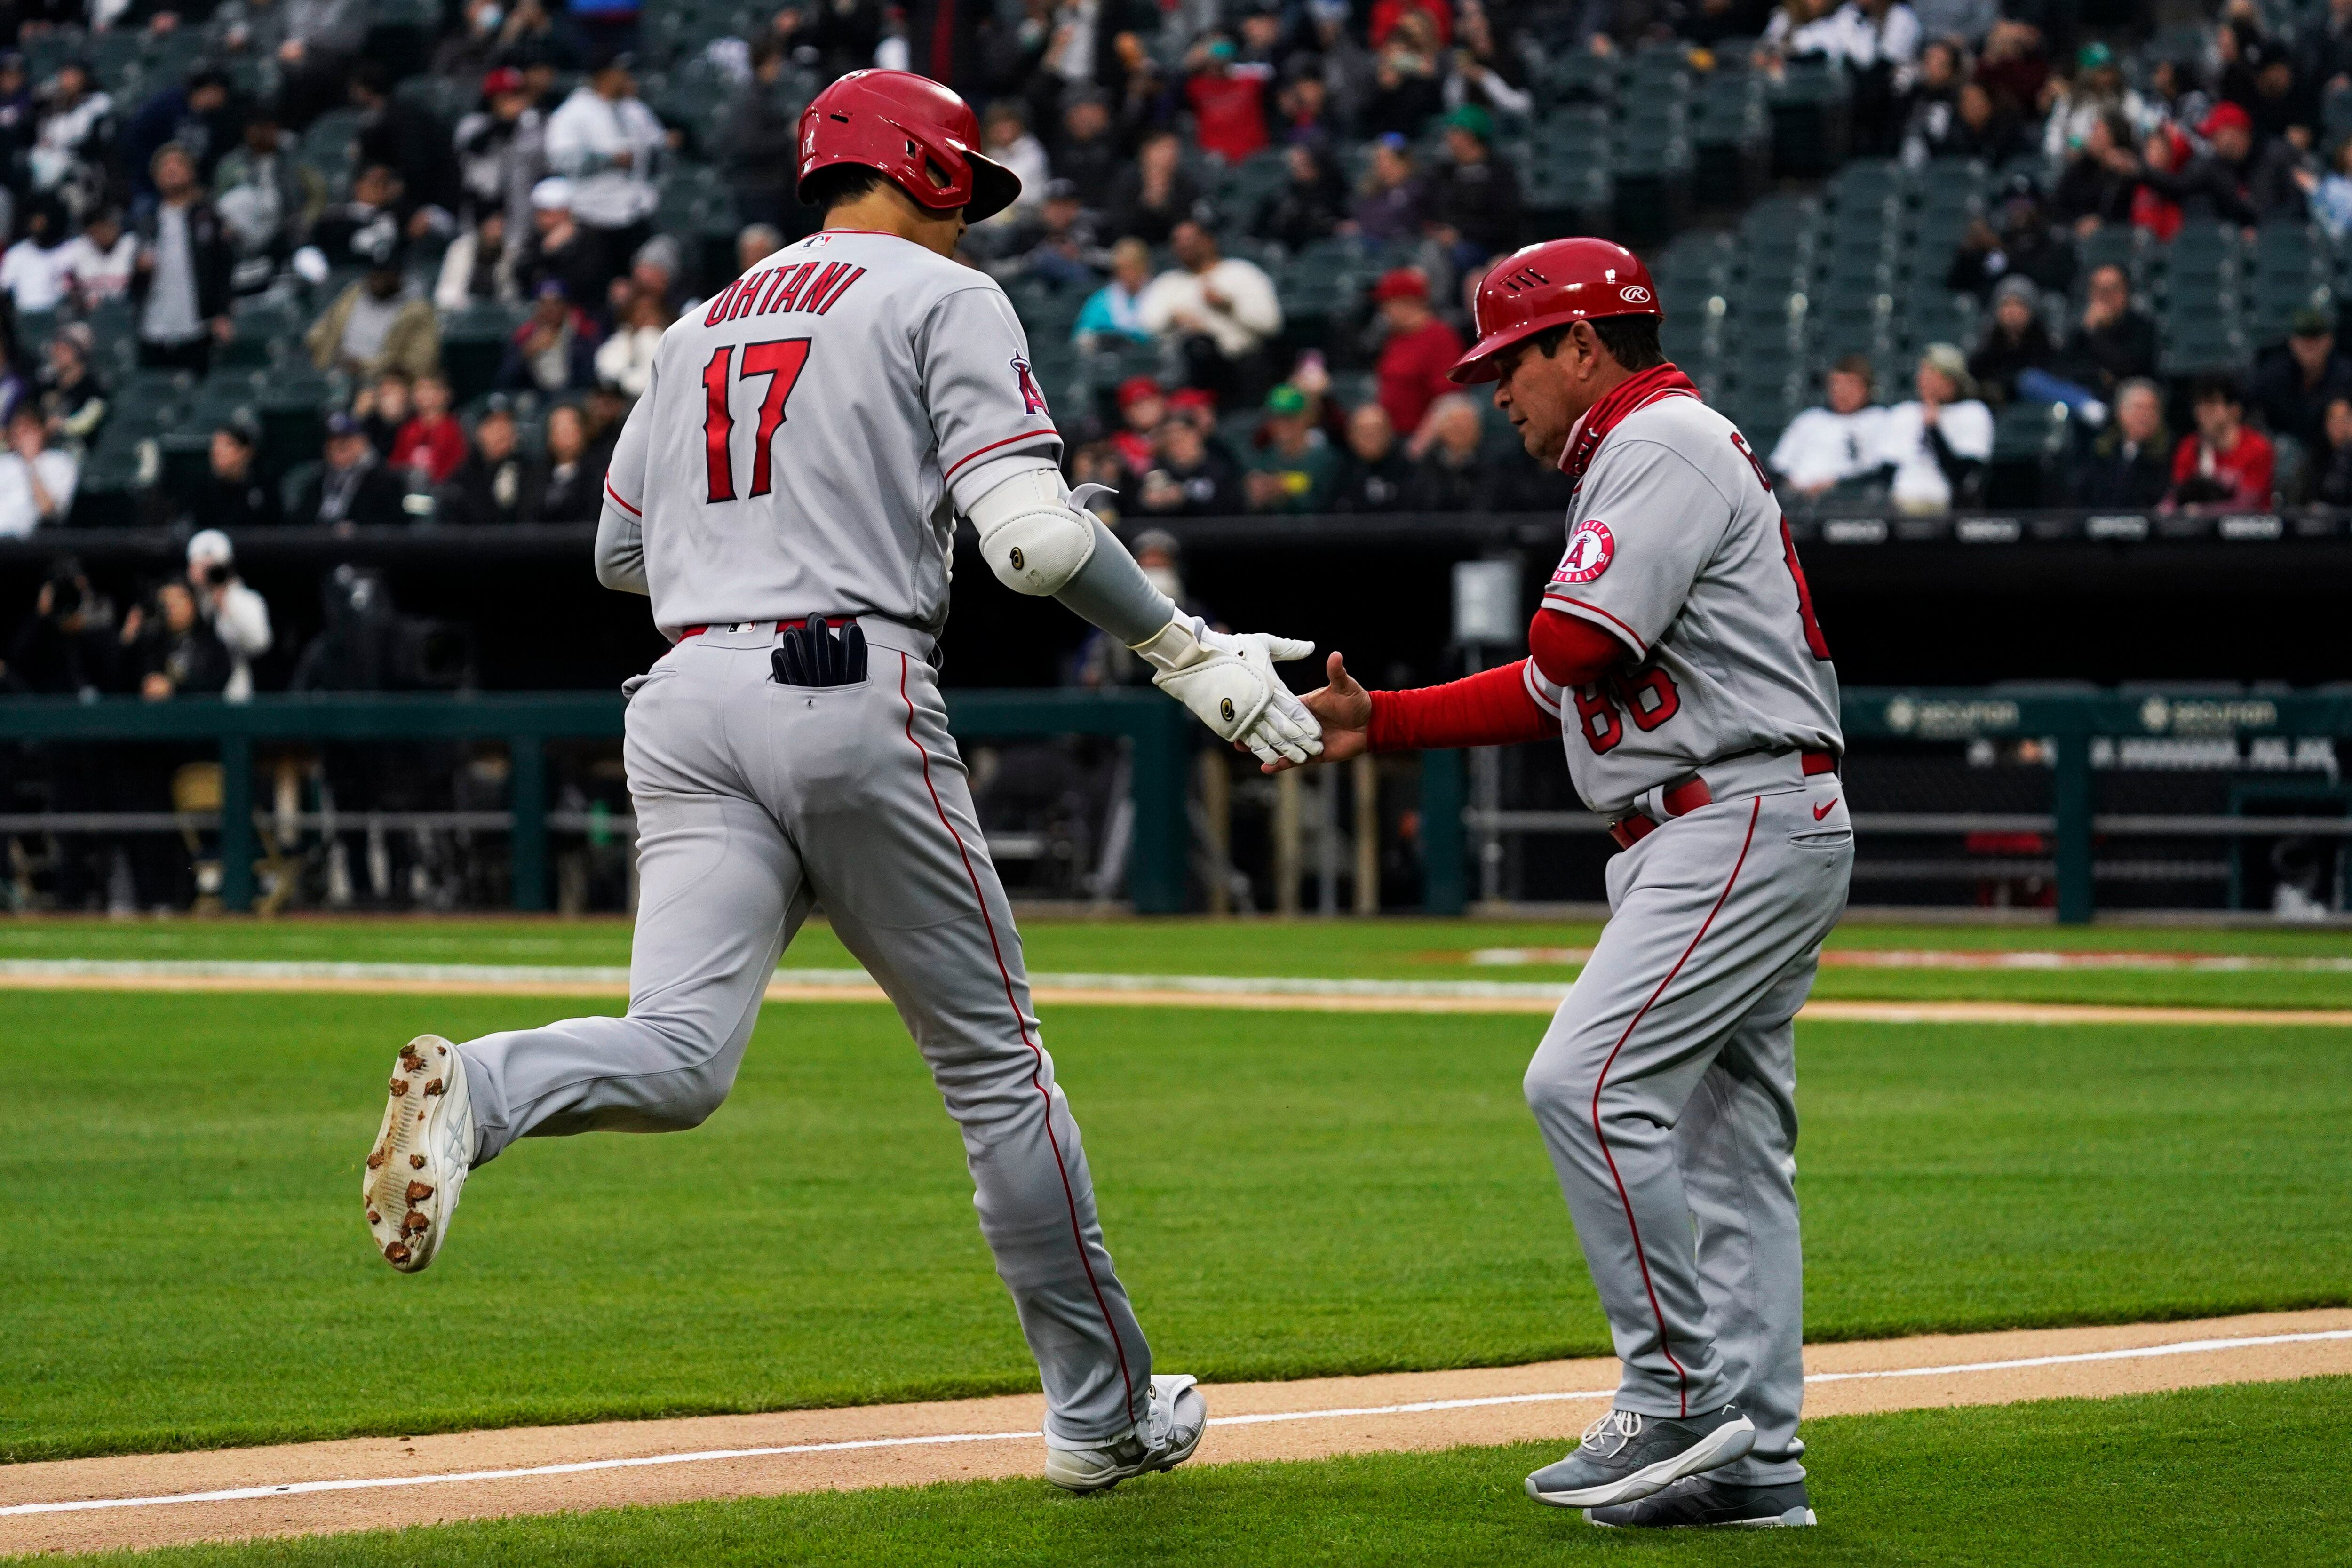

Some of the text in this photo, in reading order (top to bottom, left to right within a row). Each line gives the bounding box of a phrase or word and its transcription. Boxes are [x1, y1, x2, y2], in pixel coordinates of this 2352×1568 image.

[704, 261, 867, 328] OHTANI
[702, 336, 812, 504] 17
[1573, 521, 1611, 539] NGELS
[1552, 567, 1600, 581] SEBALL
